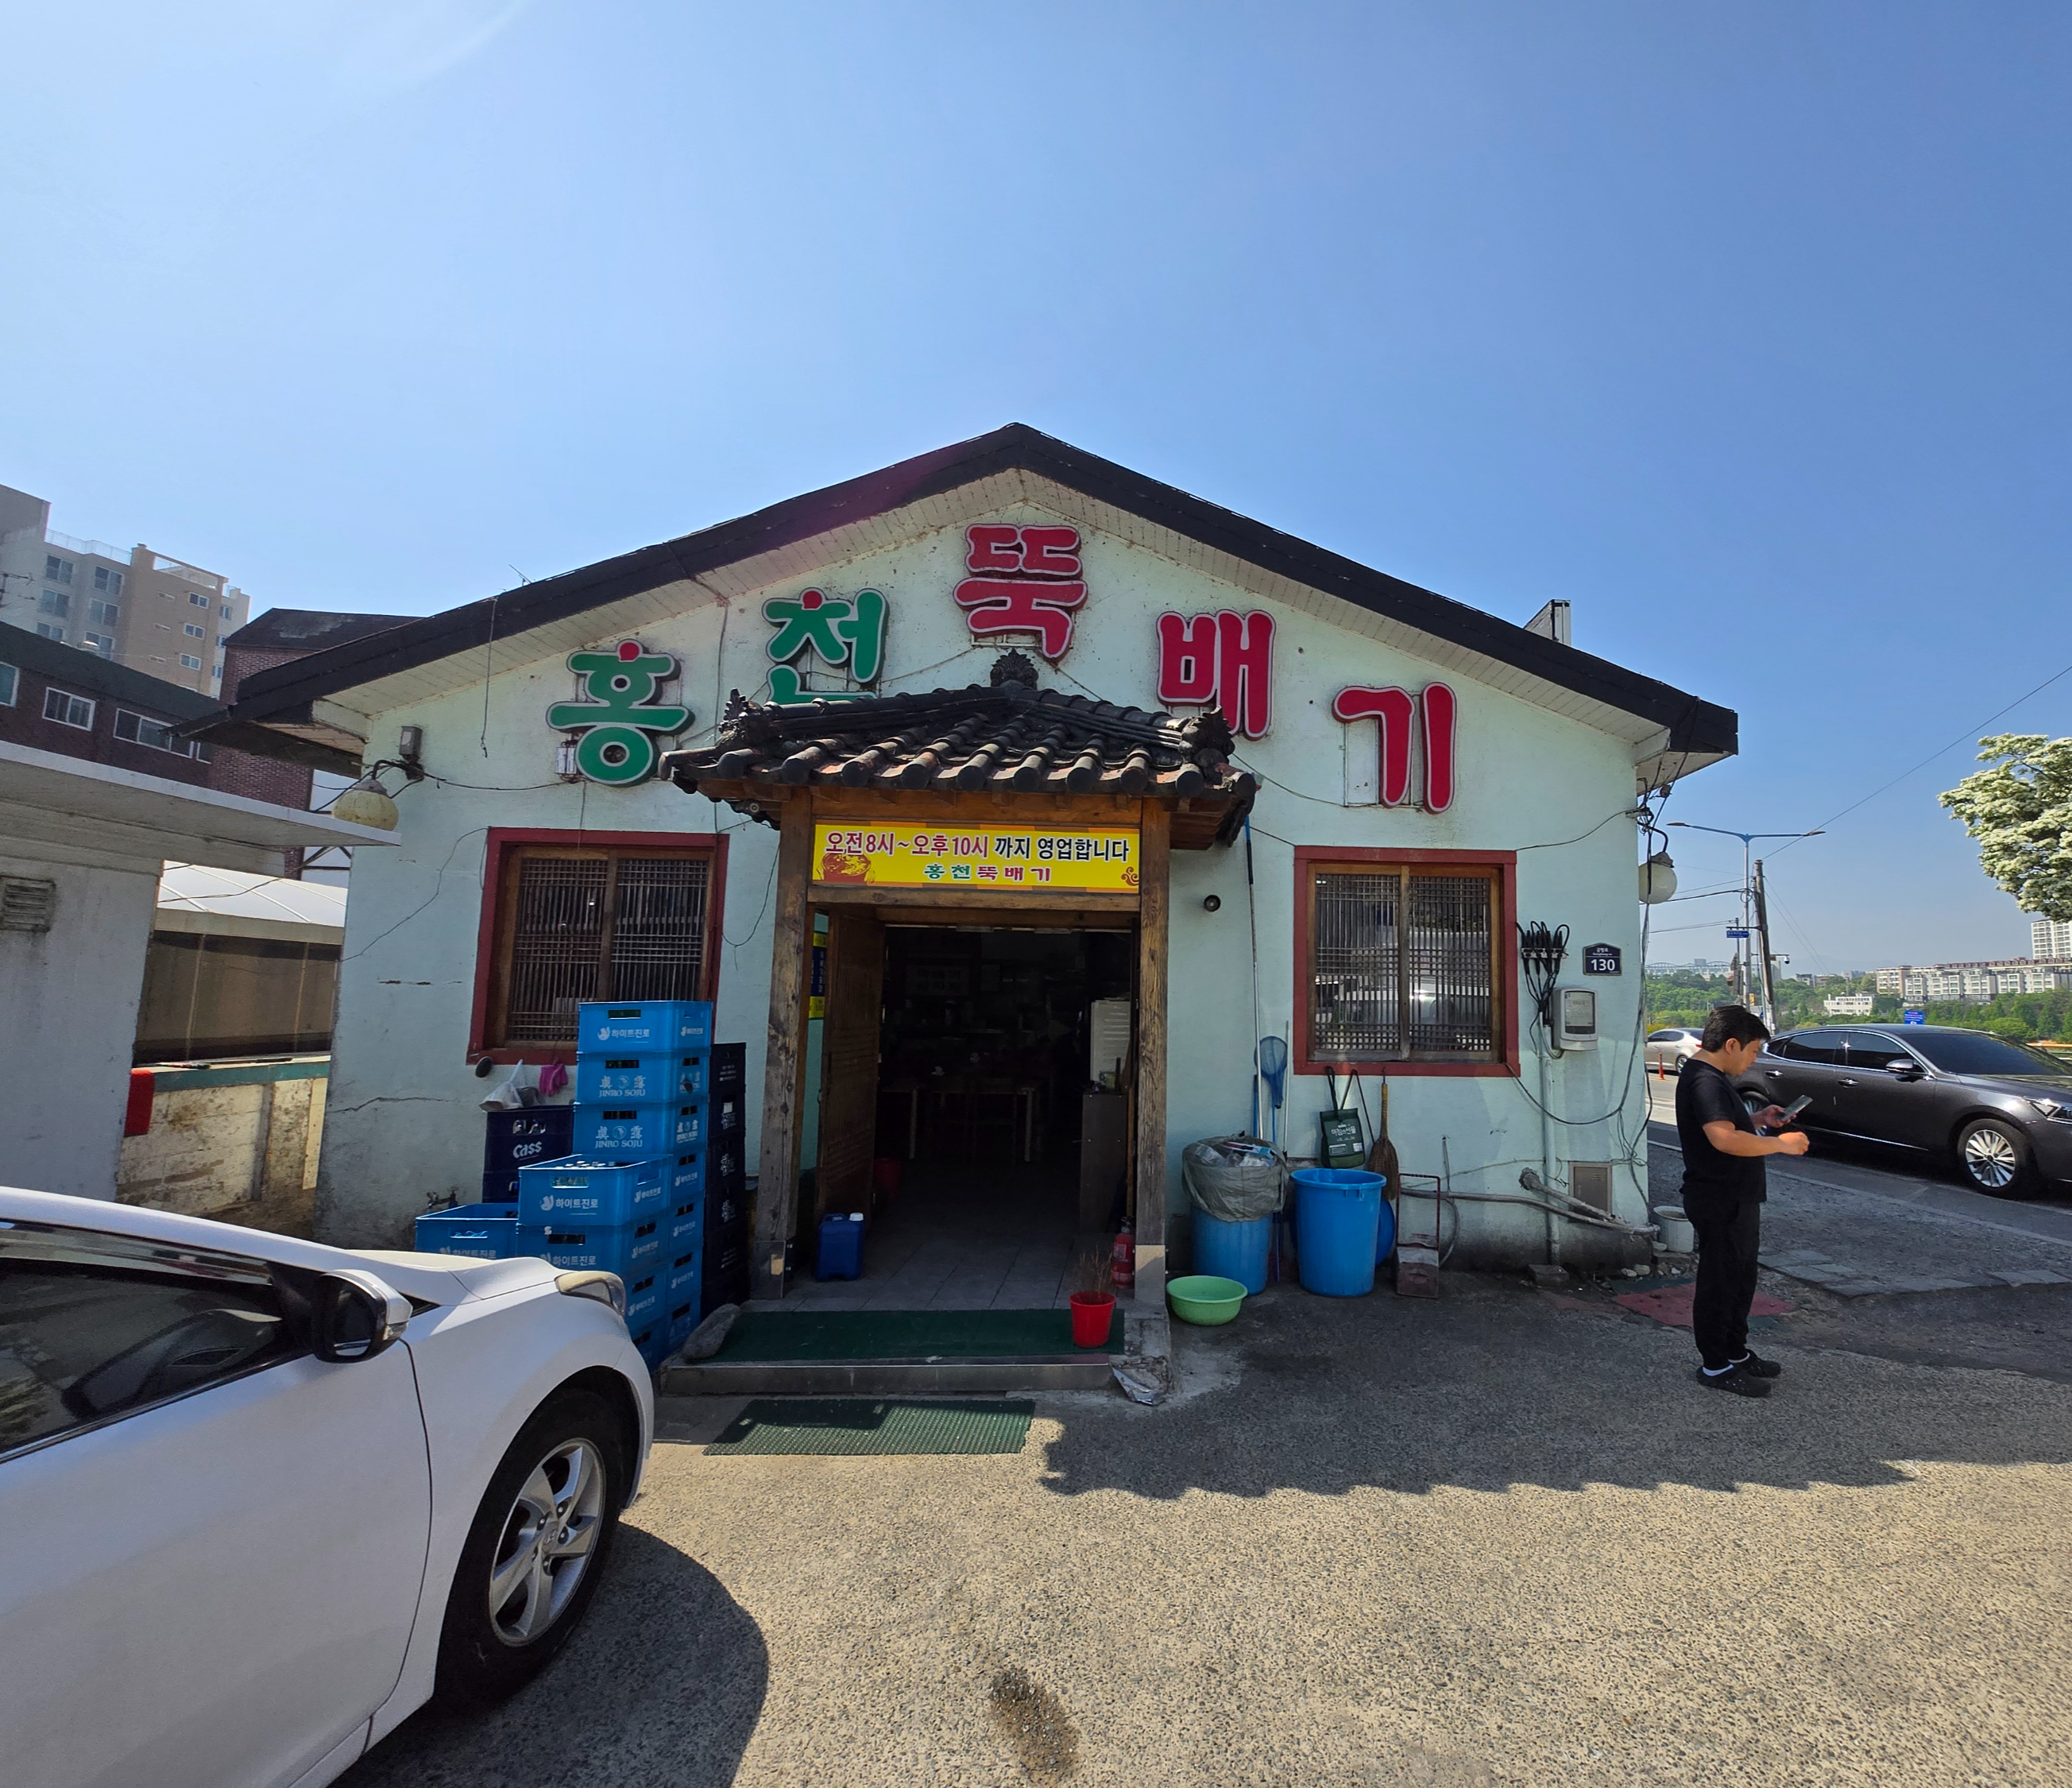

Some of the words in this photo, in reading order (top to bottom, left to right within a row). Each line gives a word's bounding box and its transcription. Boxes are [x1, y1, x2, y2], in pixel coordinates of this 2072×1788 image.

[547, 586, 889, 787] 홍천
[953, 523, 1458, 815] 뚝배기
[995, 837, 1030, 859] 까지
[1038, 837, 1129, 861] 영업합니다
[924, 863, 970, 880] 홍천
[978, 865, 1051, 882] 뚝배기
[1591, 958, 1616, 971] 130
[611, 1028, 650, 1039] 하이트진로
[599, 1089, 623, 1097] JINRO
[594, 1140, 620, 1149] JINRO
[620, 1140, 644, 1148] SOJU
[555, 1198, 599, 1209] 하이트진로
[552, 1256, 597, 1267] 하이트진로
